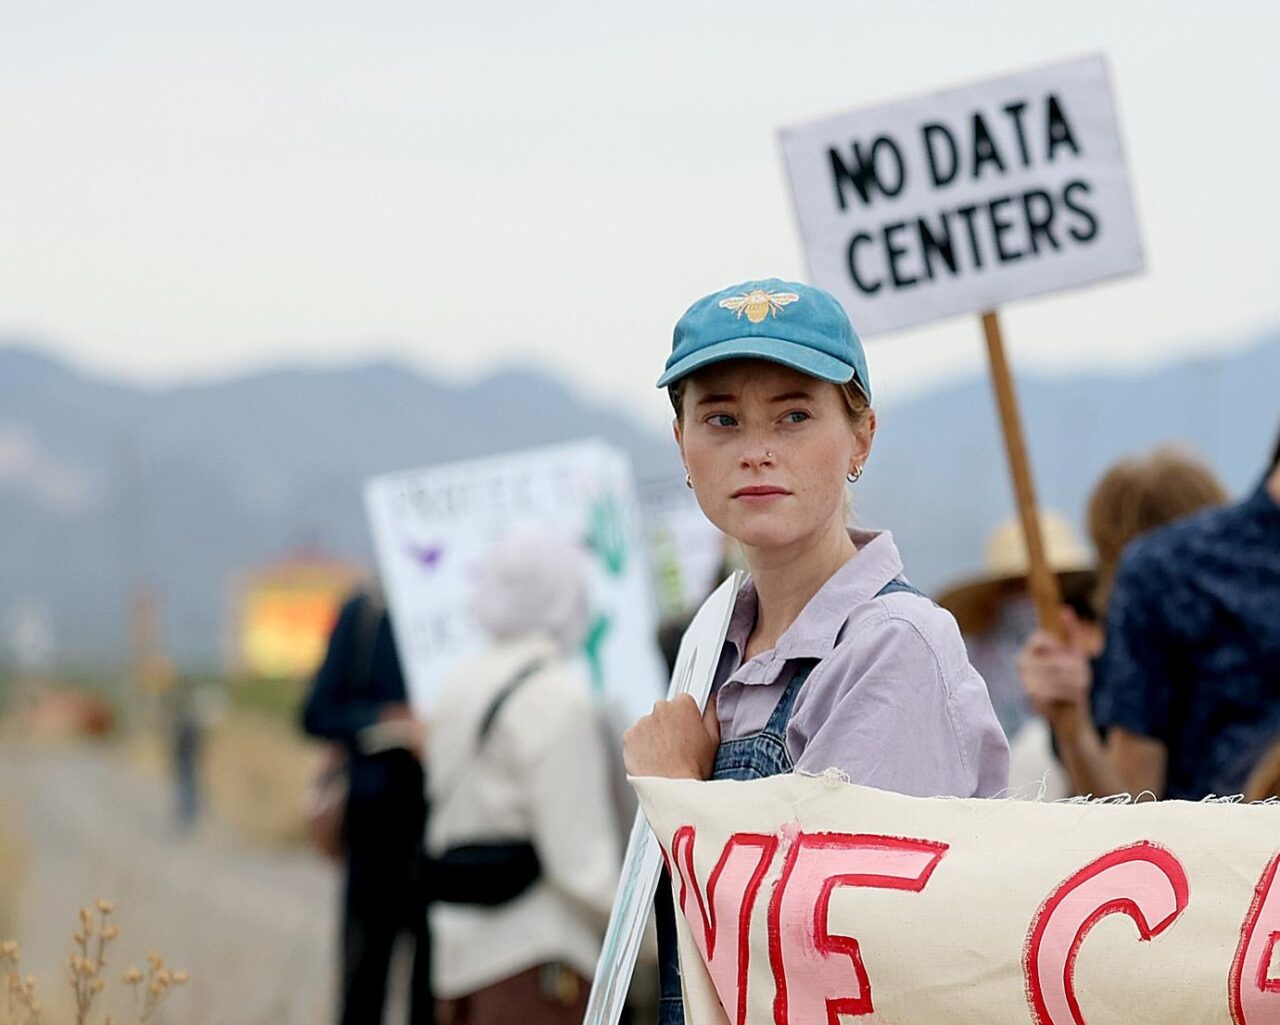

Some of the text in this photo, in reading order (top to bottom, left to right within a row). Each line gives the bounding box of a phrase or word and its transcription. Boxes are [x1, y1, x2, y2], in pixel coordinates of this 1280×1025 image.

[826, 93, 1081, 212] NO DATA
[846, 180, 1099, 294] CENTERS
